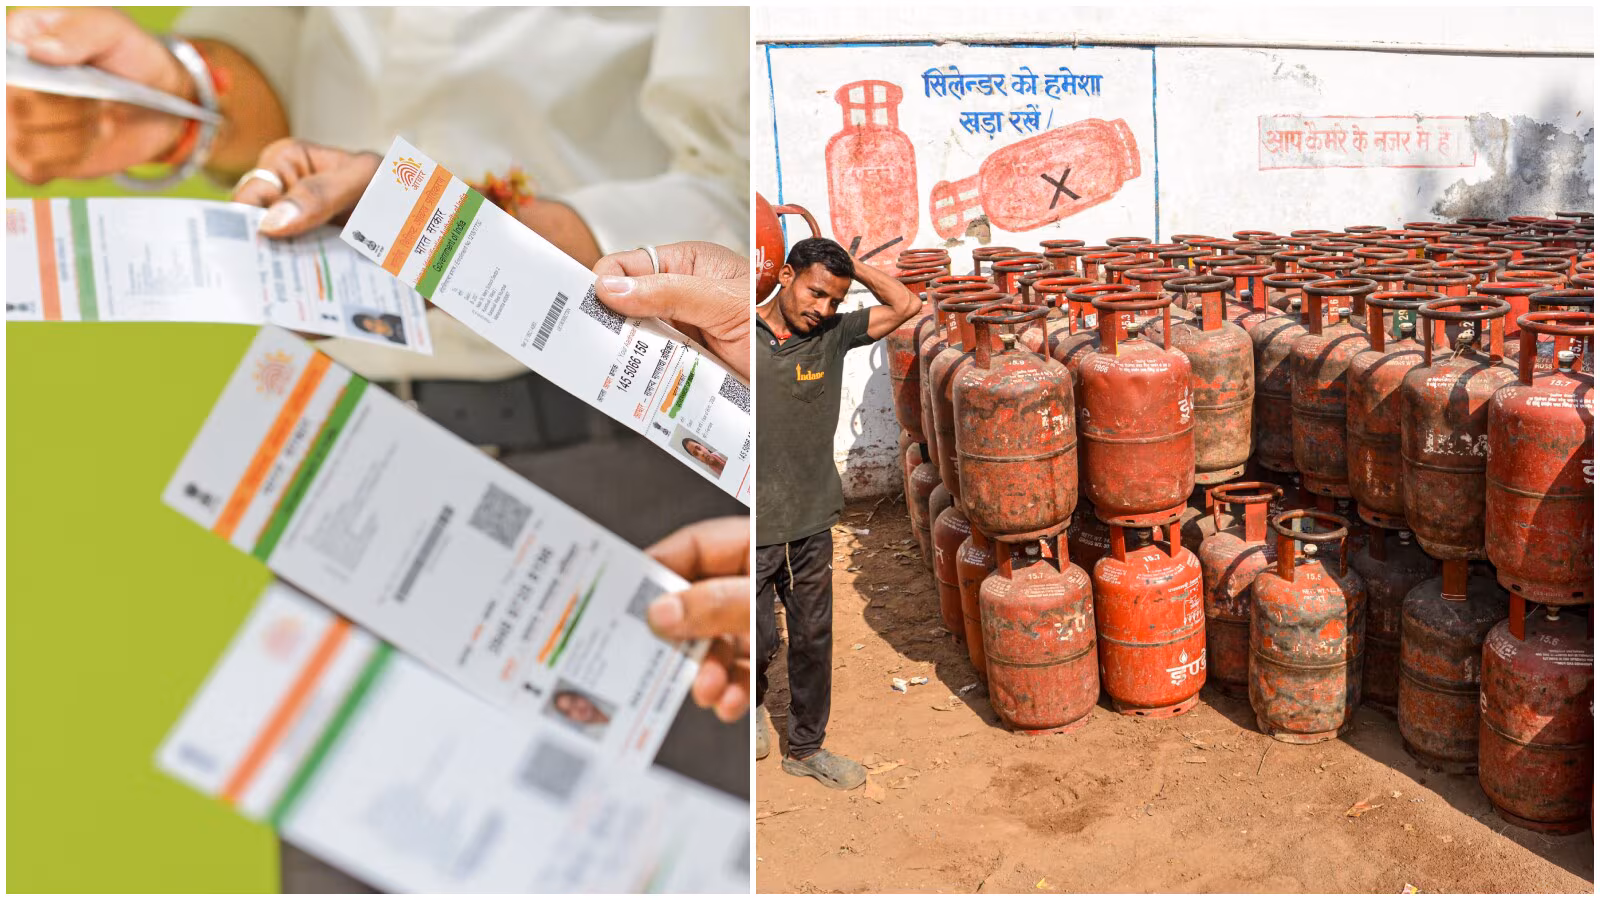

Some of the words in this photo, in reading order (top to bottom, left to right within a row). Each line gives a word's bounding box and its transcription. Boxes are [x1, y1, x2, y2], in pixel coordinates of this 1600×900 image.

[1011, 66, 1039, 95] को
[1044, 66, 1103, 100] हमेशा
[959, 111, 1004, 140] खड़ा
[415, 235, 431, 255] भारत
[426, 208, 446, 235] सरकार
[453, 220, 466, 234] India
[450, 232, 459, 241] of
[432, 239, 455, 272] Government
[619, 347, 628, 359] Your
[633, 340, 649, 358] 150
[624, 355, 642, 378] 5066
[796, 363, 825, 381] Indane
[617, 376, 633, 394] 145
